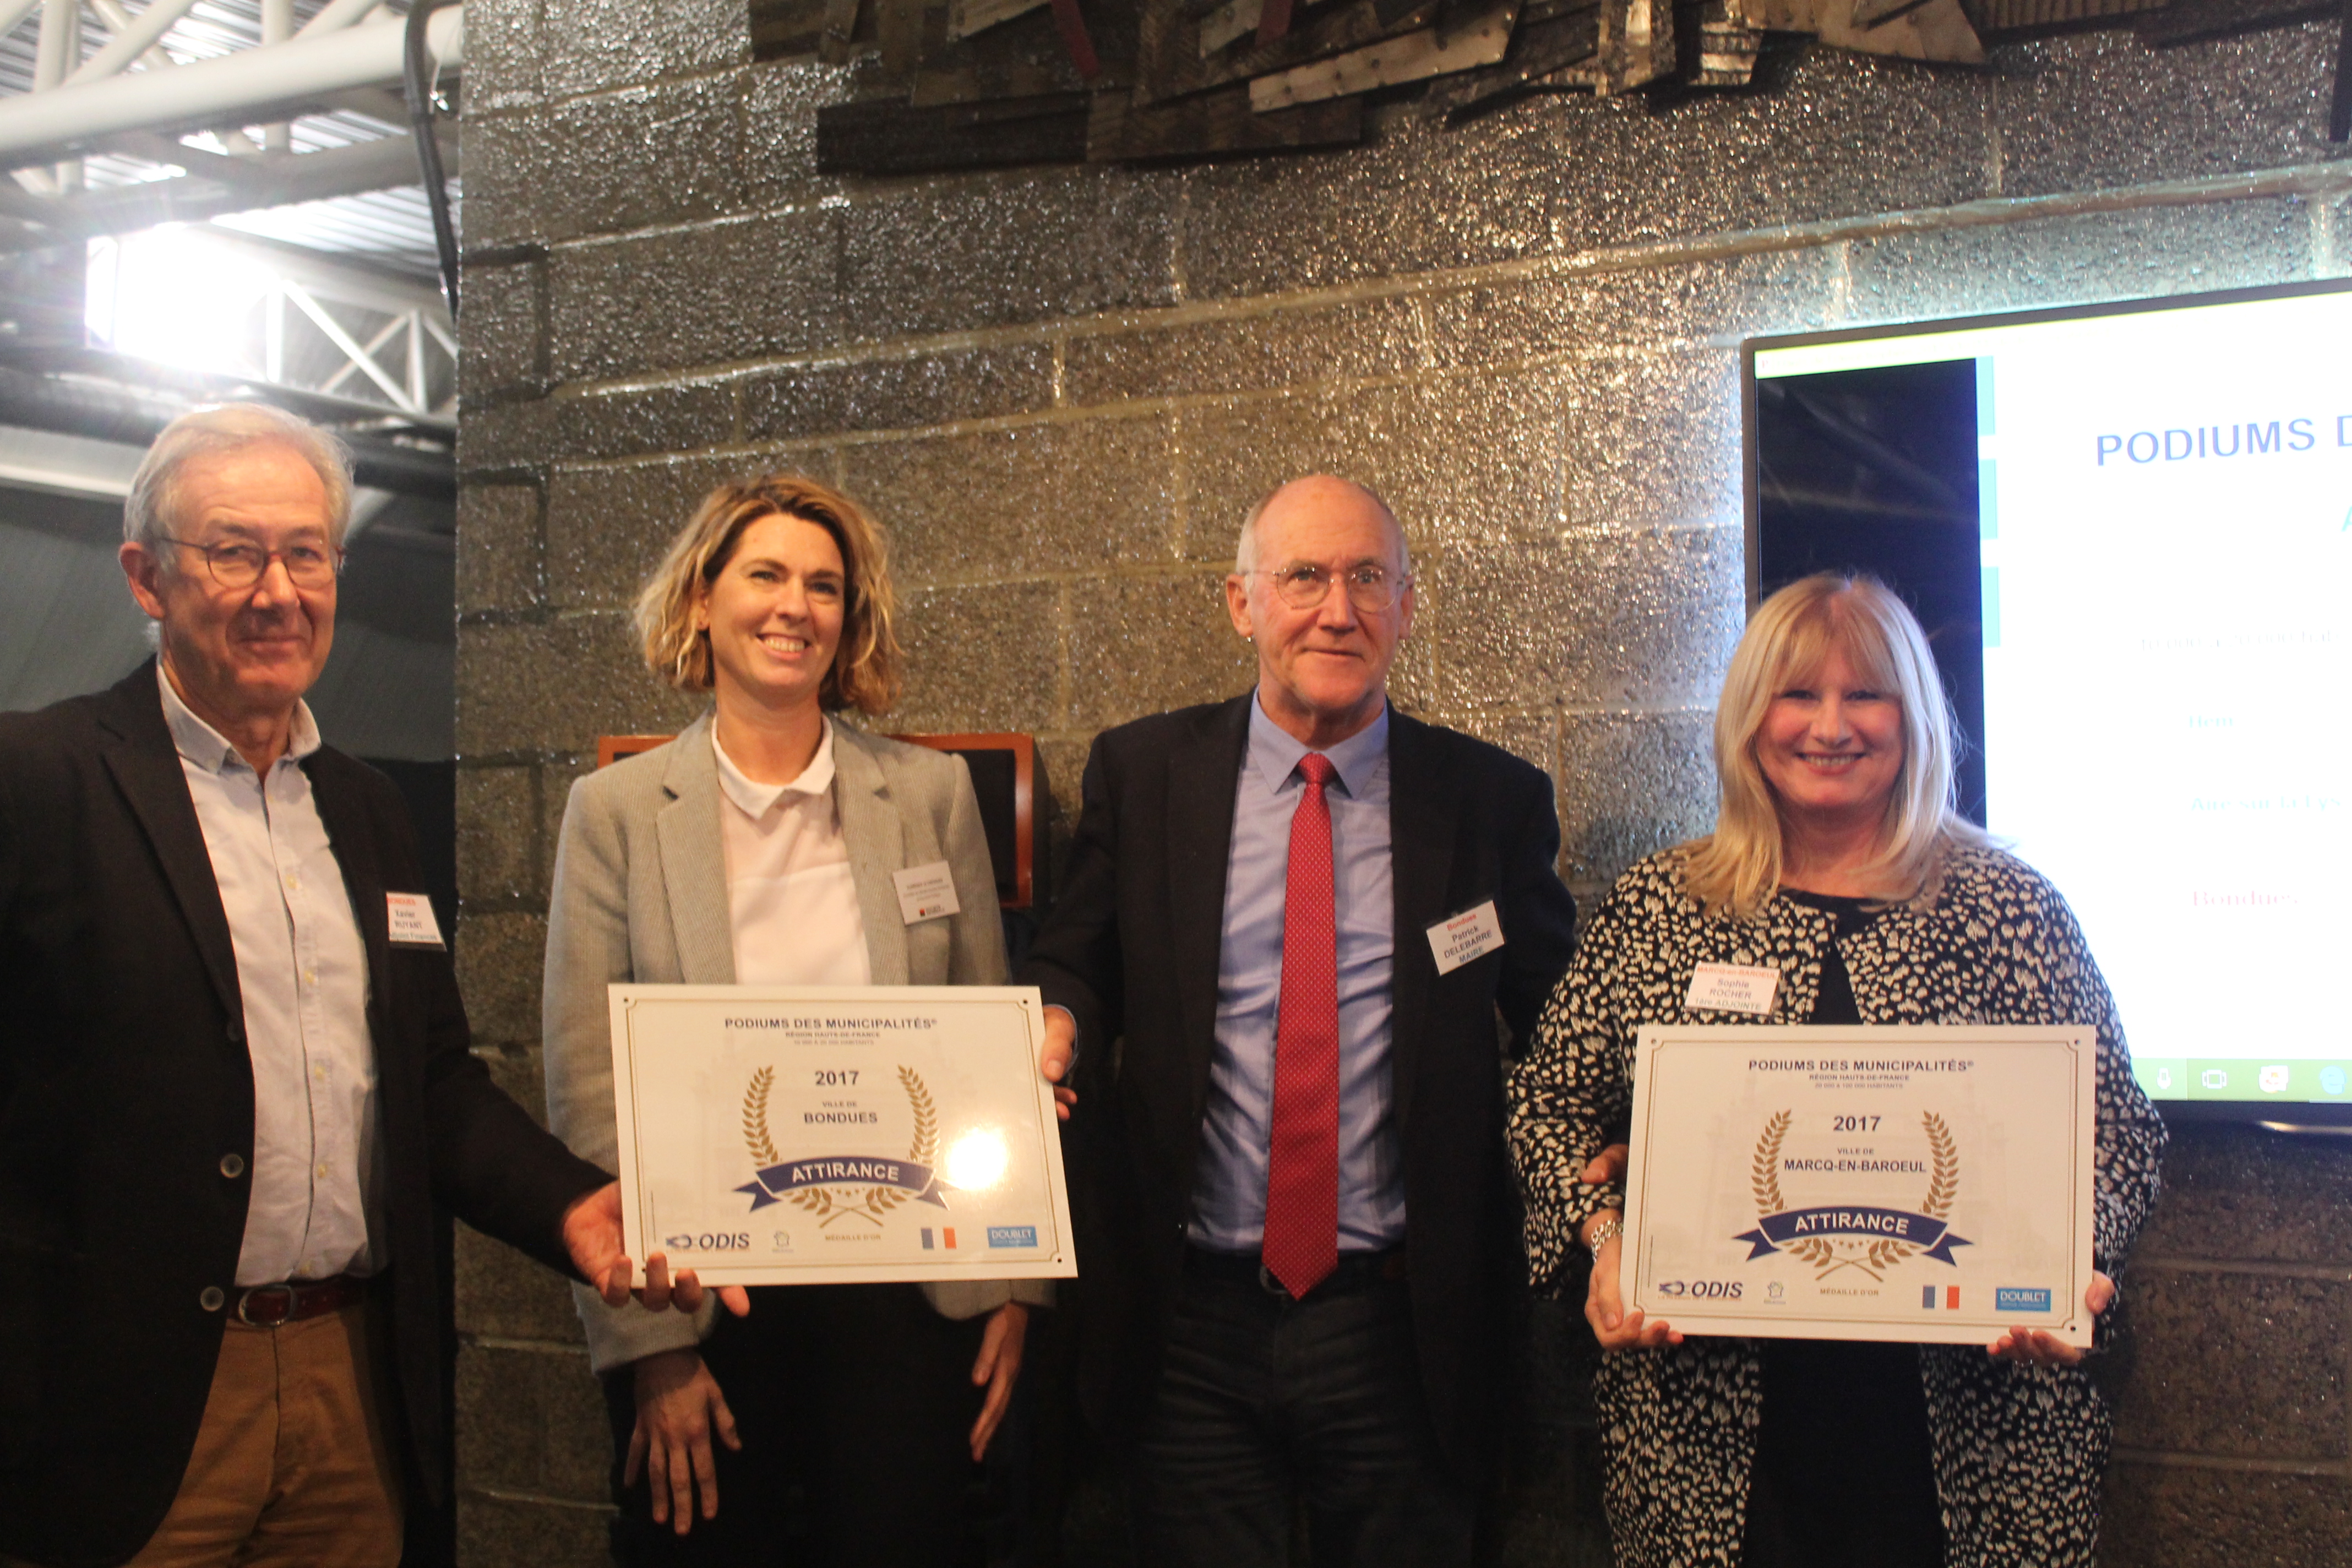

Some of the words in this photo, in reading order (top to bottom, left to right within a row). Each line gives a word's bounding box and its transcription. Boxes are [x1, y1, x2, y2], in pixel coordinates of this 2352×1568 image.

[2097, 418, 2315, 466] PODIUMS
[1447, 913, 1477, 932] Bondues
[1452, 925, 1479, 943] Patrick
[1444, 929, 1493, 959] DELEBARRE
[1459, 945, 1485, 963] MAIRE
[1717, 978, 1750, 989] Sophie
[1709, 988, 1752, 1000] ROCHER
[725, 1018, 790, 1029] PODIUMS
[794, 1018, 822, 1029] DES
[1749, 1059, 1815, 1071] PODIUMS
[1820, 1059, 1849, 1071] DES
[815, 1070, 859, 1086] 2017
[804, 1112, 878, 1124] BONDUES
[1833, 1115, 1881, 1132] 2017
[792, 1161, 900, 1184] ATTIRANCE
[1784, 1159, 1927, 1173] MARCQ-EN-BAROEUL
[1795, 1212, 1910, 1235] ATTIRANCE
[699, 1232, 750, 1250] ODIS
[992, 1228, 1032, 1240] DOUBLET
[1691, 1281, 1744, 1298] ODIS
[2000, 1291, 2046, 1303] DOUBLET
